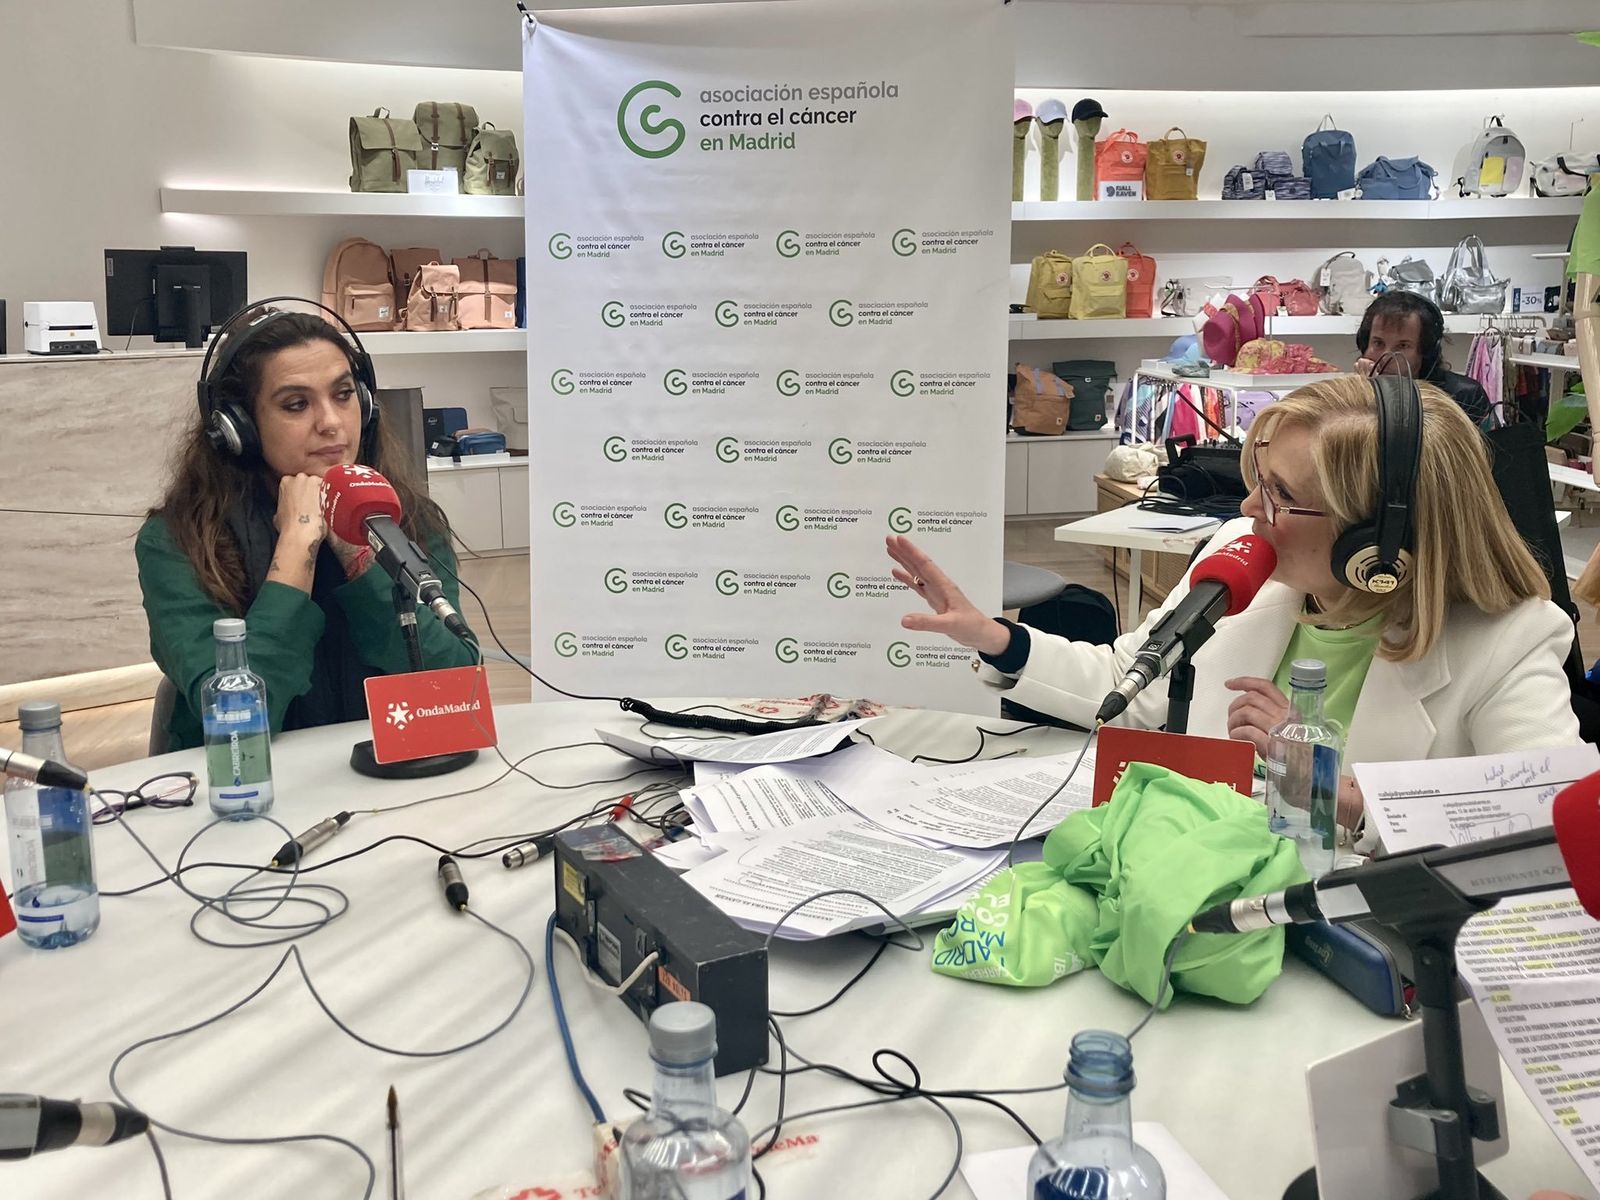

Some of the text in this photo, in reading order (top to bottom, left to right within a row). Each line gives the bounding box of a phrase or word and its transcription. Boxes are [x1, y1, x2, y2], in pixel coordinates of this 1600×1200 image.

[700, 81, 899, 104] asociación española
[700, 106, 857, 126] contra el cáncer
[700, 132, 796, 151] en Madrid
[843, 231, 875, 239] española
[961, 229, 993, 237] española
[1522, 296, 1542, 305] -30%
[895, 440, 926, 448] española
[955, 510, 987, 518] española
[780, 573, 810, 581] española
[840, 641, 871, 649] española
[934, 940, 1005, 967] ADRID
